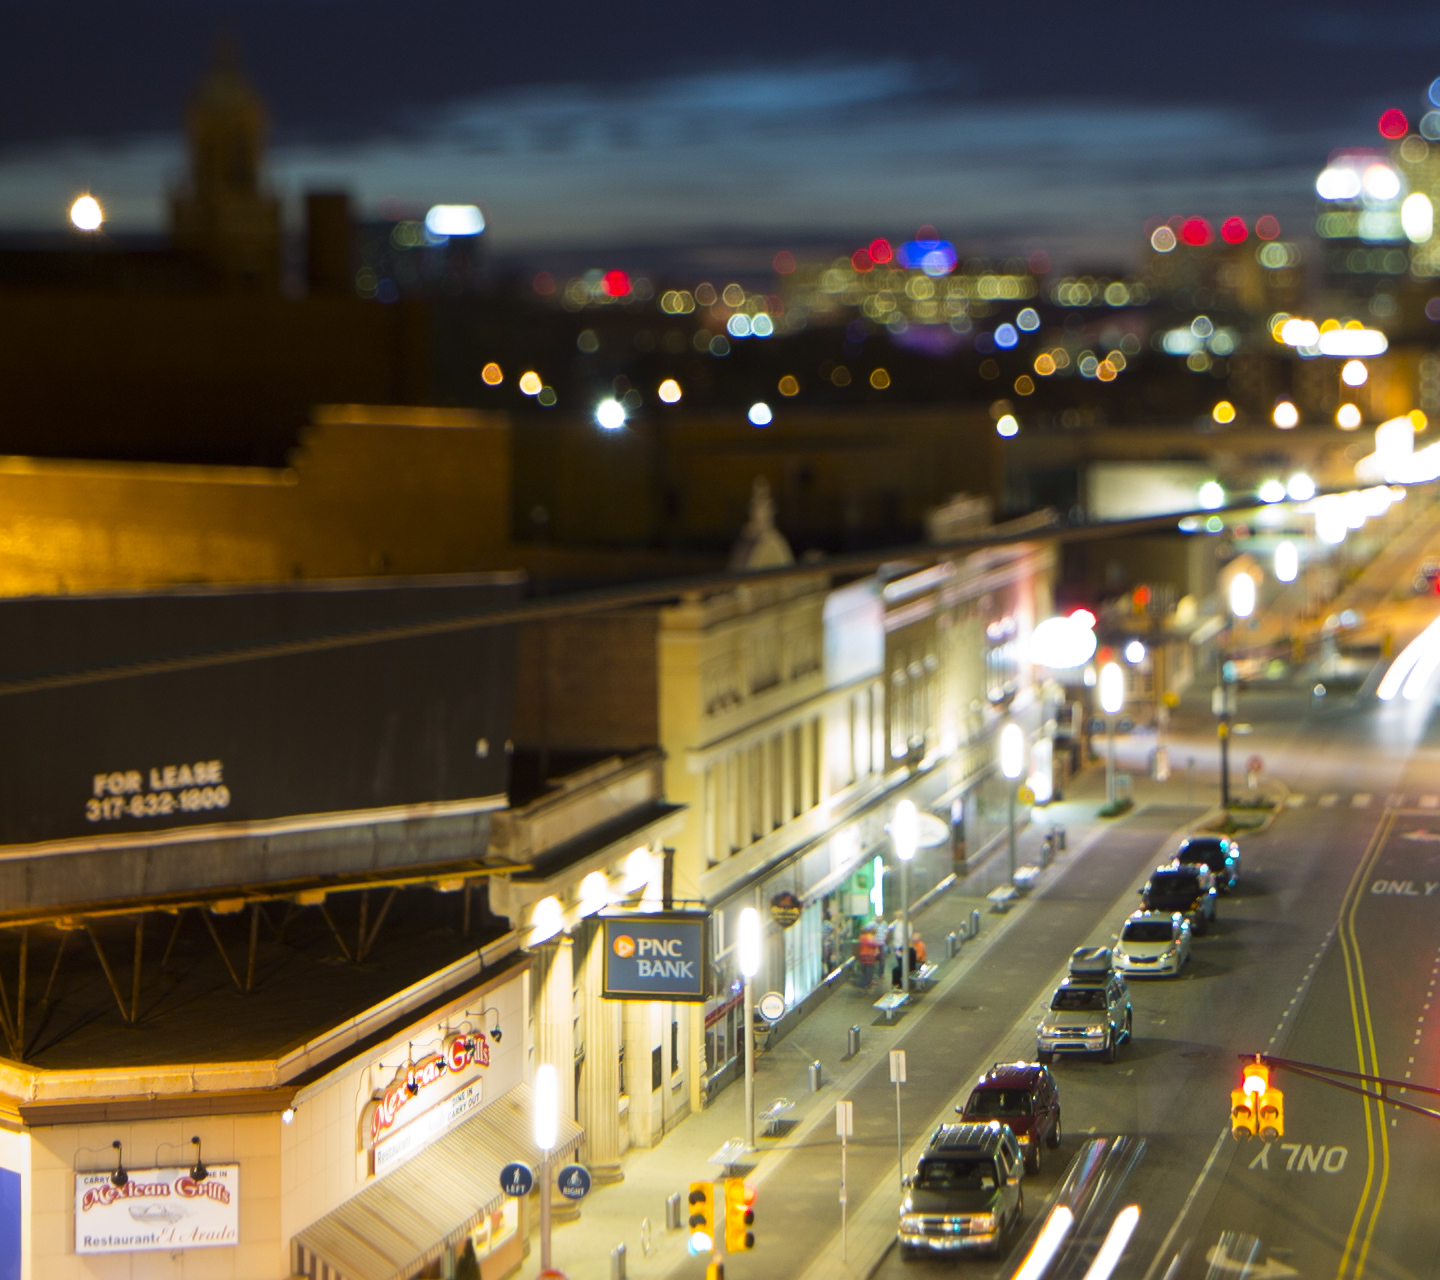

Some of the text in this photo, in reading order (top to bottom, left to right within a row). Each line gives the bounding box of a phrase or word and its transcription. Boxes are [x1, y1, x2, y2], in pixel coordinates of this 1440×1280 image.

[93, 760, 223, 796] FOR LEASE
[1371, 879, 1439, 896] ONLY
[636, 938, 682, 957] PNC
[636, 960, 694, 978] BANK
[466, 1087, 473, 1097] IN
[468, 1093, 480, 1108] OUT
[1247, 1142, 1349, 1173] ONLY
[83, 1175, 109, 1185] CARRY
[219, 1170, 228, 1178] IN
[82, 1176, 231, 1212] Mexican Grills
[506, 1184, 526, 1194] LEFT
[84, 1232, 156, 1247] Restaurant
